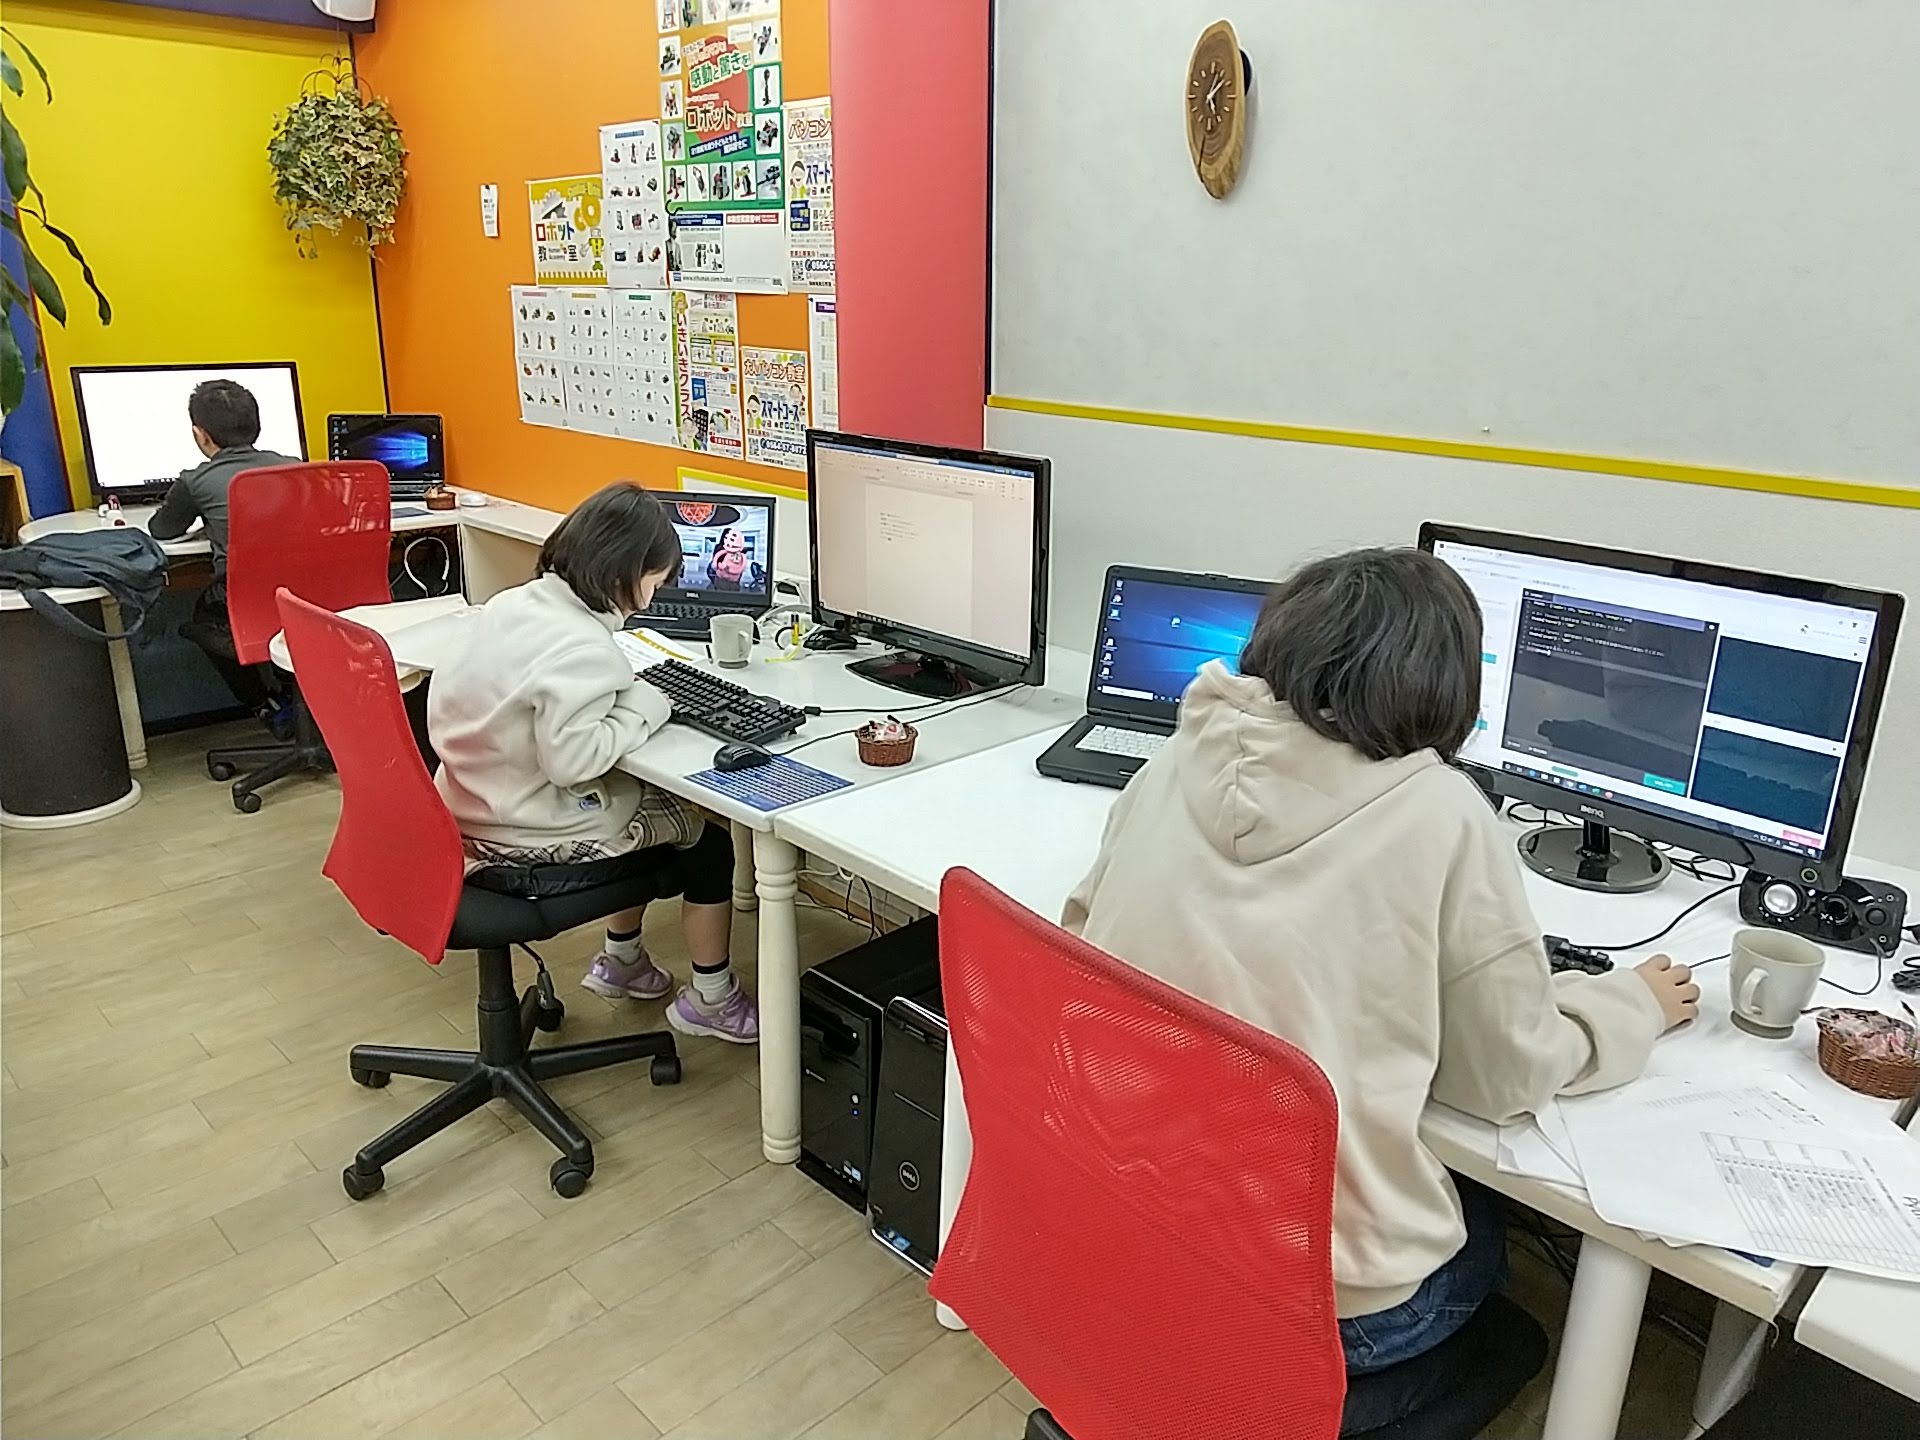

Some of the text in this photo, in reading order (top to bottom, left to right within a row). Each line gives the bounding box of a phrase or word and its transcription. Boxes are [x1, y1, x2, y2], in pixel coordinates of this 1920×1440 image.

[676, 312, 690, 418] いきいきクラス
[902, 1168, 917, 1185] DELL
